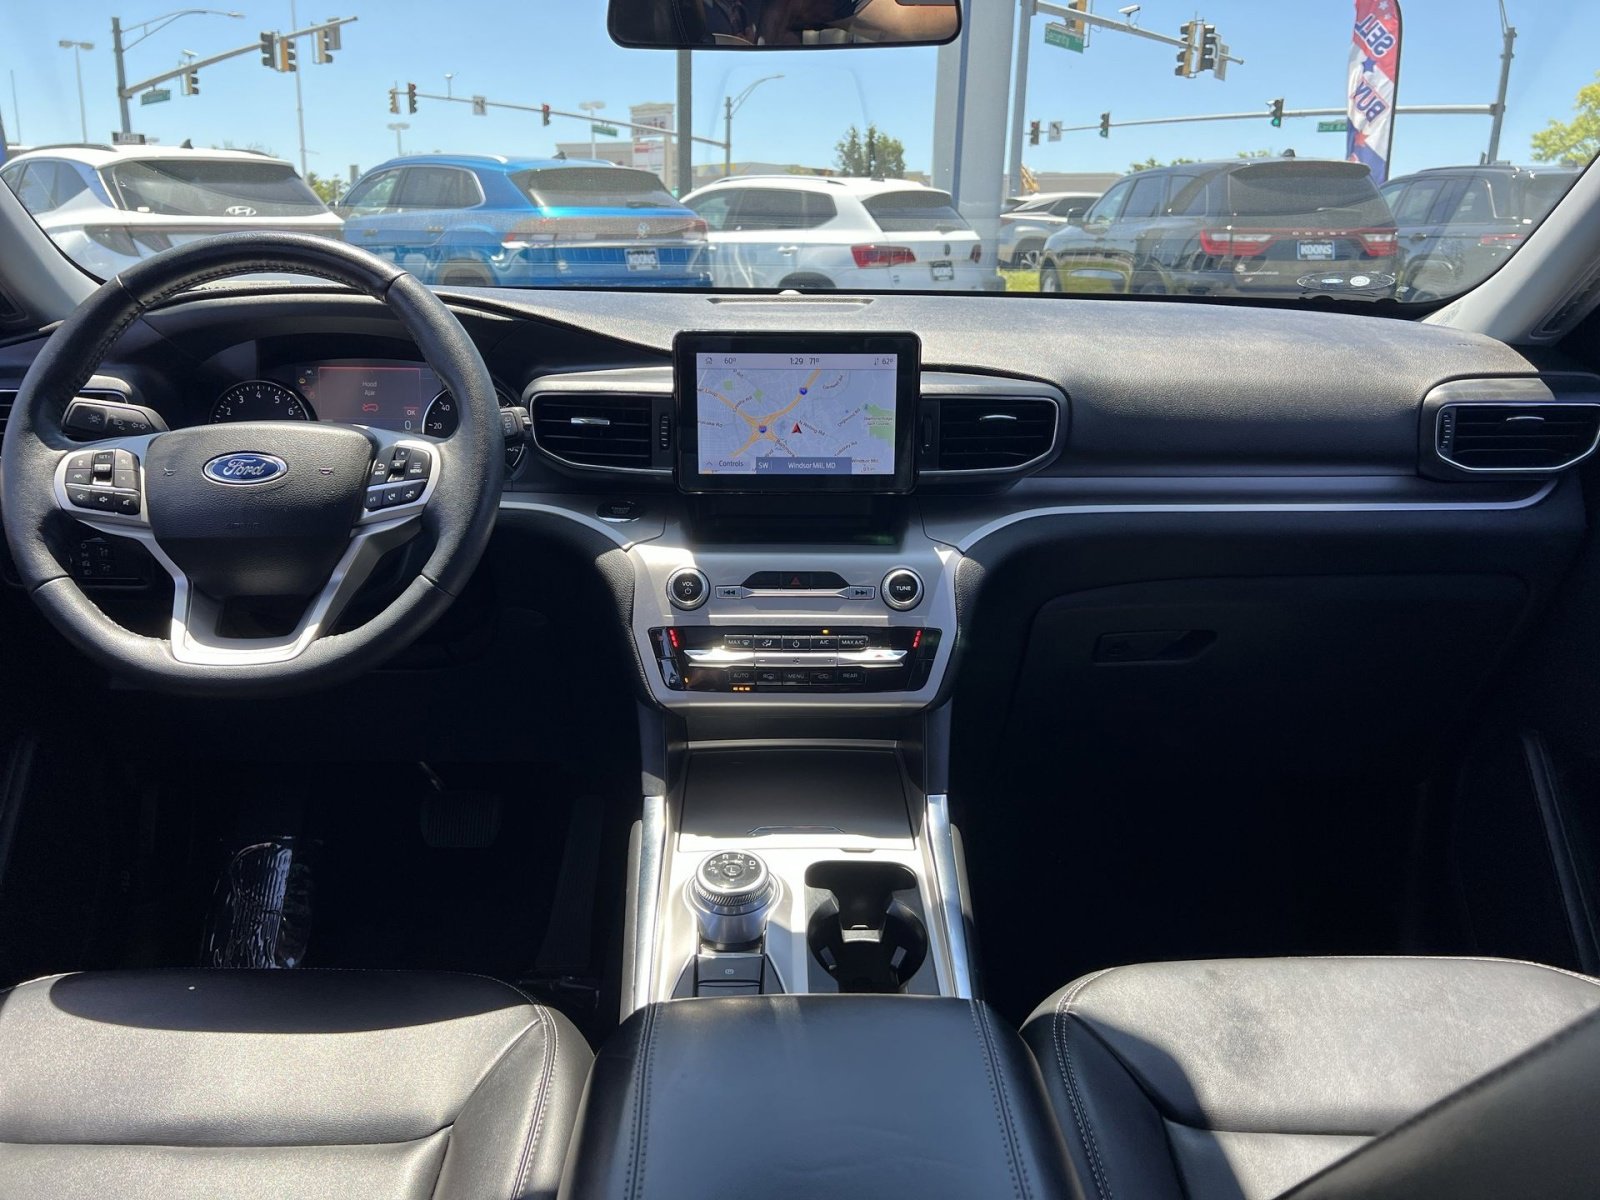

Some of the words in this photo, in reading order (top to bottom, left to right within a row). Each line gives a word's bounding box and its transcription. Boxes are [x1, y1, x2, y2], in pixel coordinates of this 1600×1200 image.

[1300, 244, 1333, 255] KOONS
[790, 357, 804, 365] 1:29
[239, 395, 244, 404] 3
[256, 391, 261, 399] 4
[274, 395, 280, 404] 5
[226, 407, 231, 416] 2
[288, 407, 294, 416] 6
[441, 404, 450, 412] 40
[404, 420, 411, 431] 0
[433, 422, 443, 430] 20
[223, 459, 266, 476] Ford
[788, 461, 812, 469] Windsor
